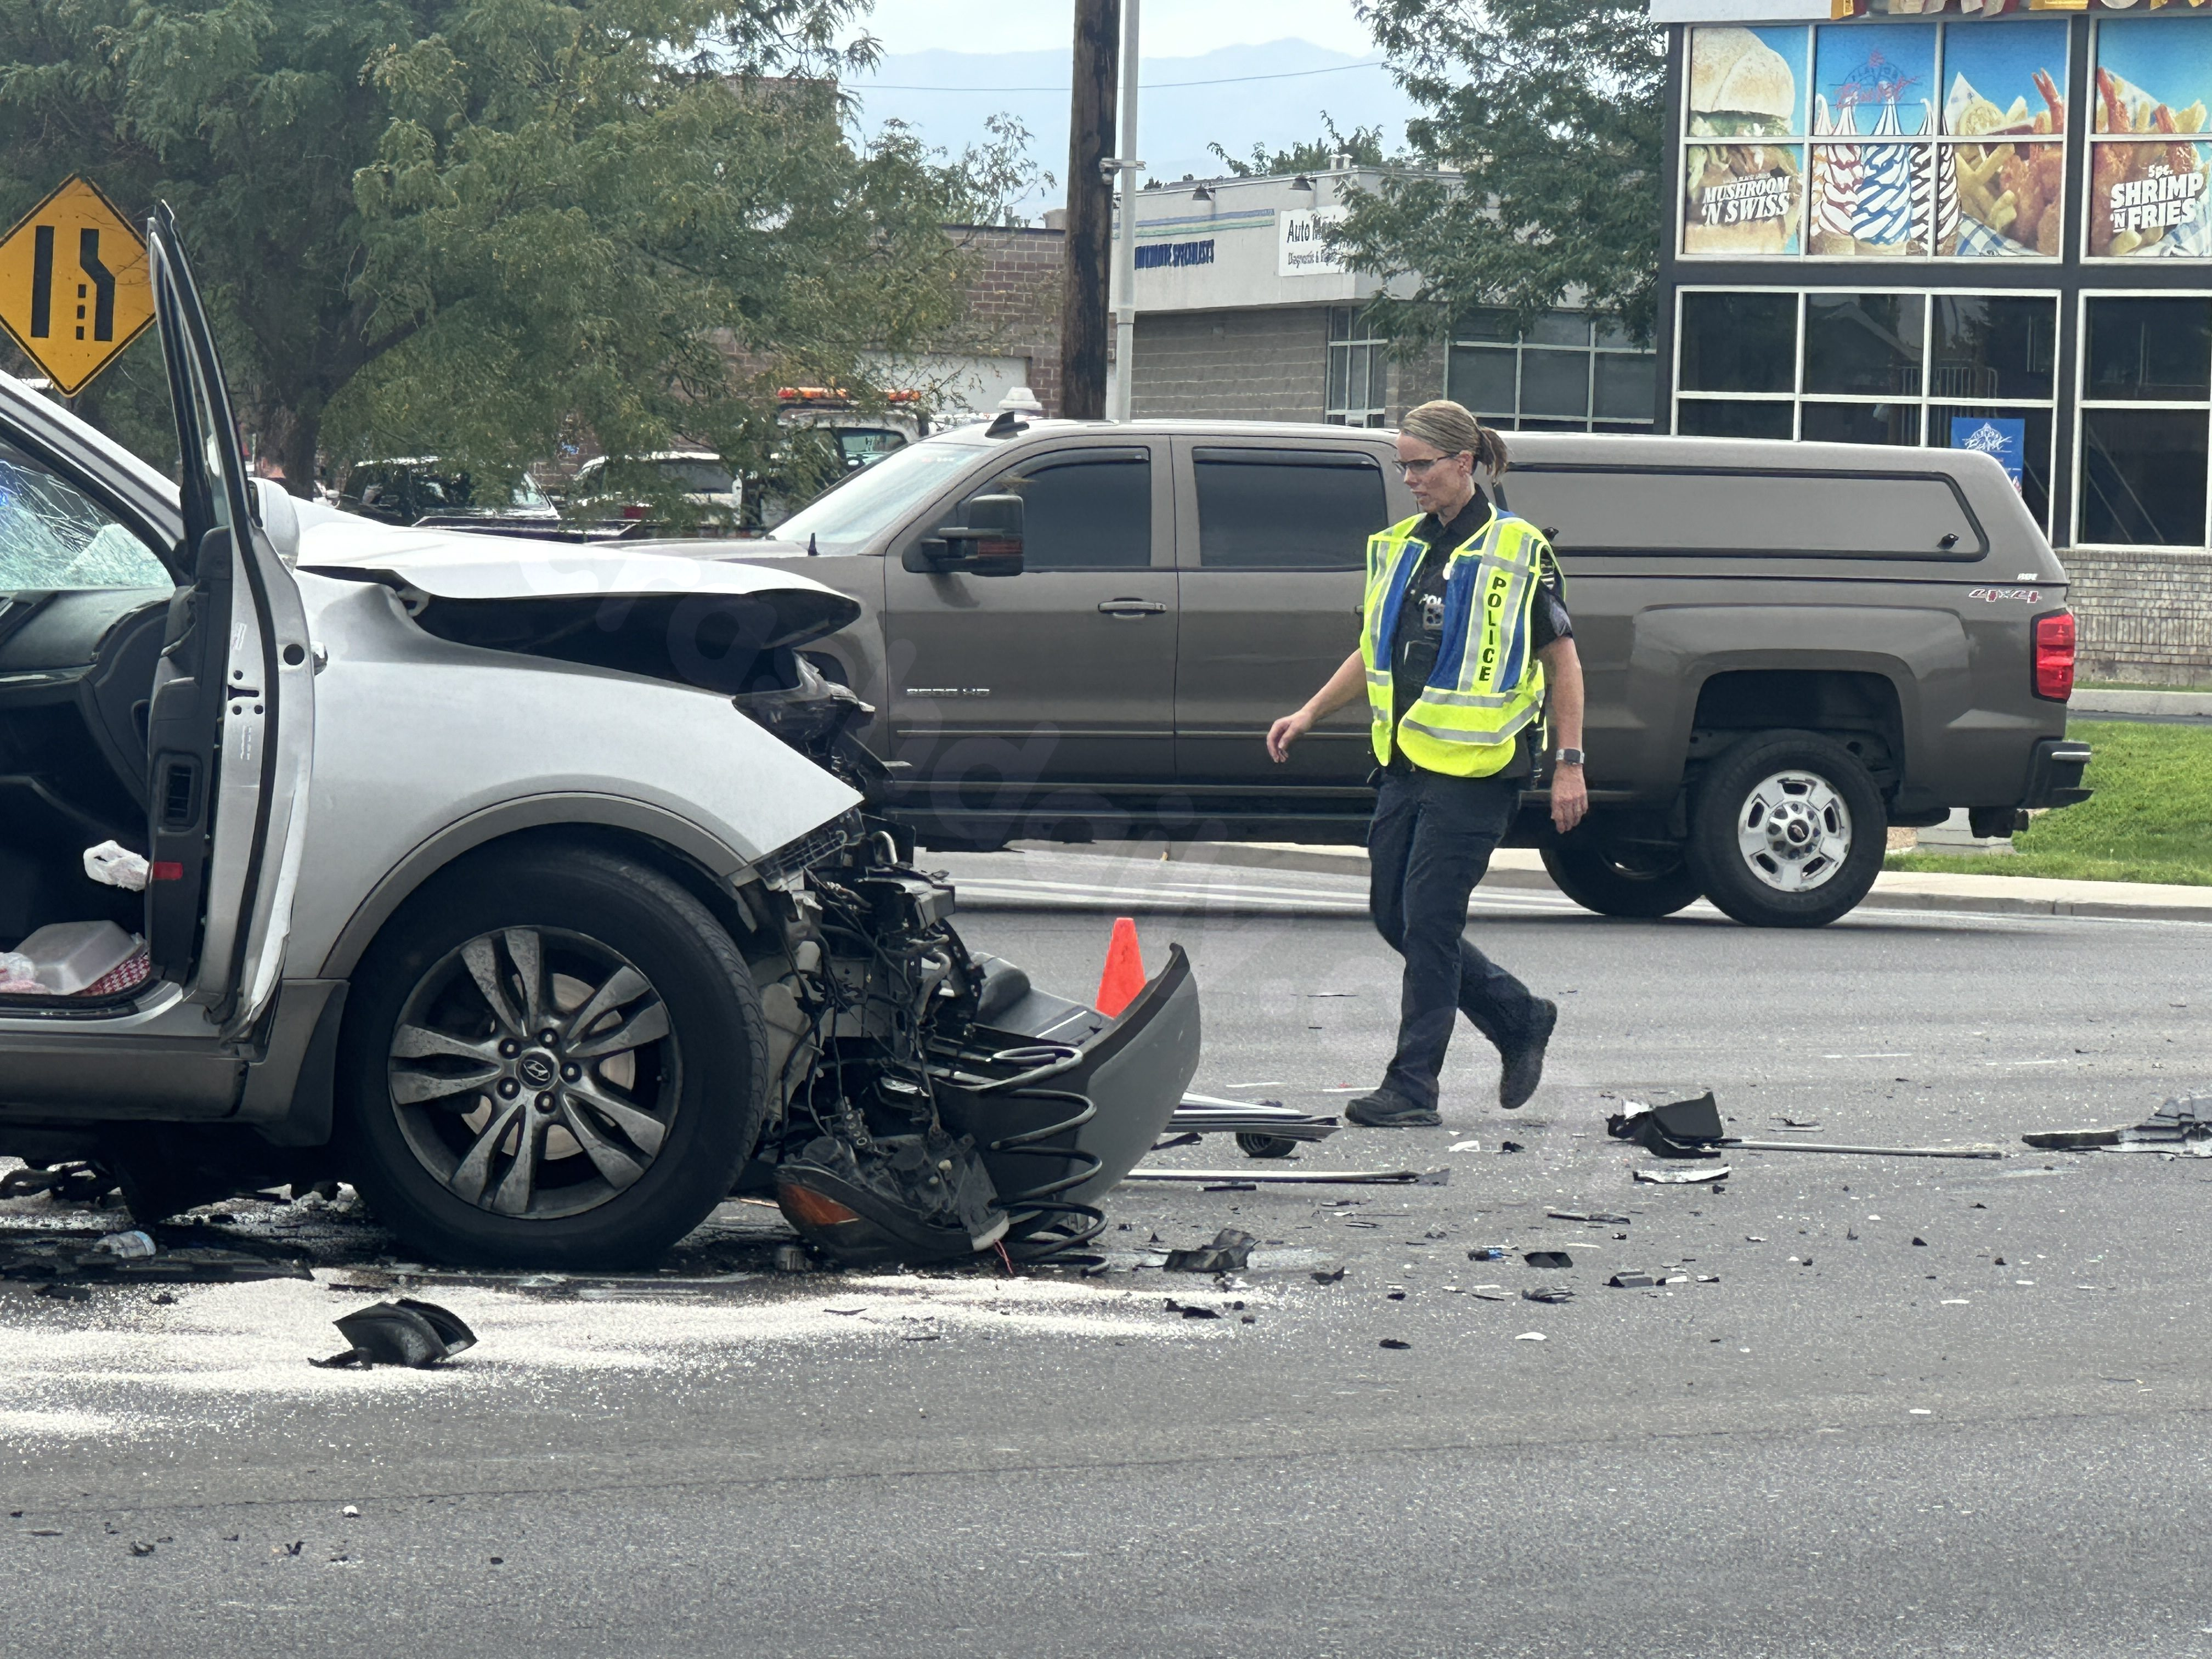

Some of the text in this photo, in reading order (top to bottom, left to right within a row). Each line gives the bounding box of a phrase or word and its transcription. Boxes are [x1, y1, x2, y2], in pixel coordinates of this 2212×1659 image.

[1702, 176, 1792, 204] MUSHROOM
[2110, 173, 2204, 209] SHRIMP
[1724, 193, 1791, 223] SWISS
[2126, 198, 2197, 230] FRIES
[1287, 219, 1310, 244] Auto
[1479, 577, 1507, 681] POLICE
